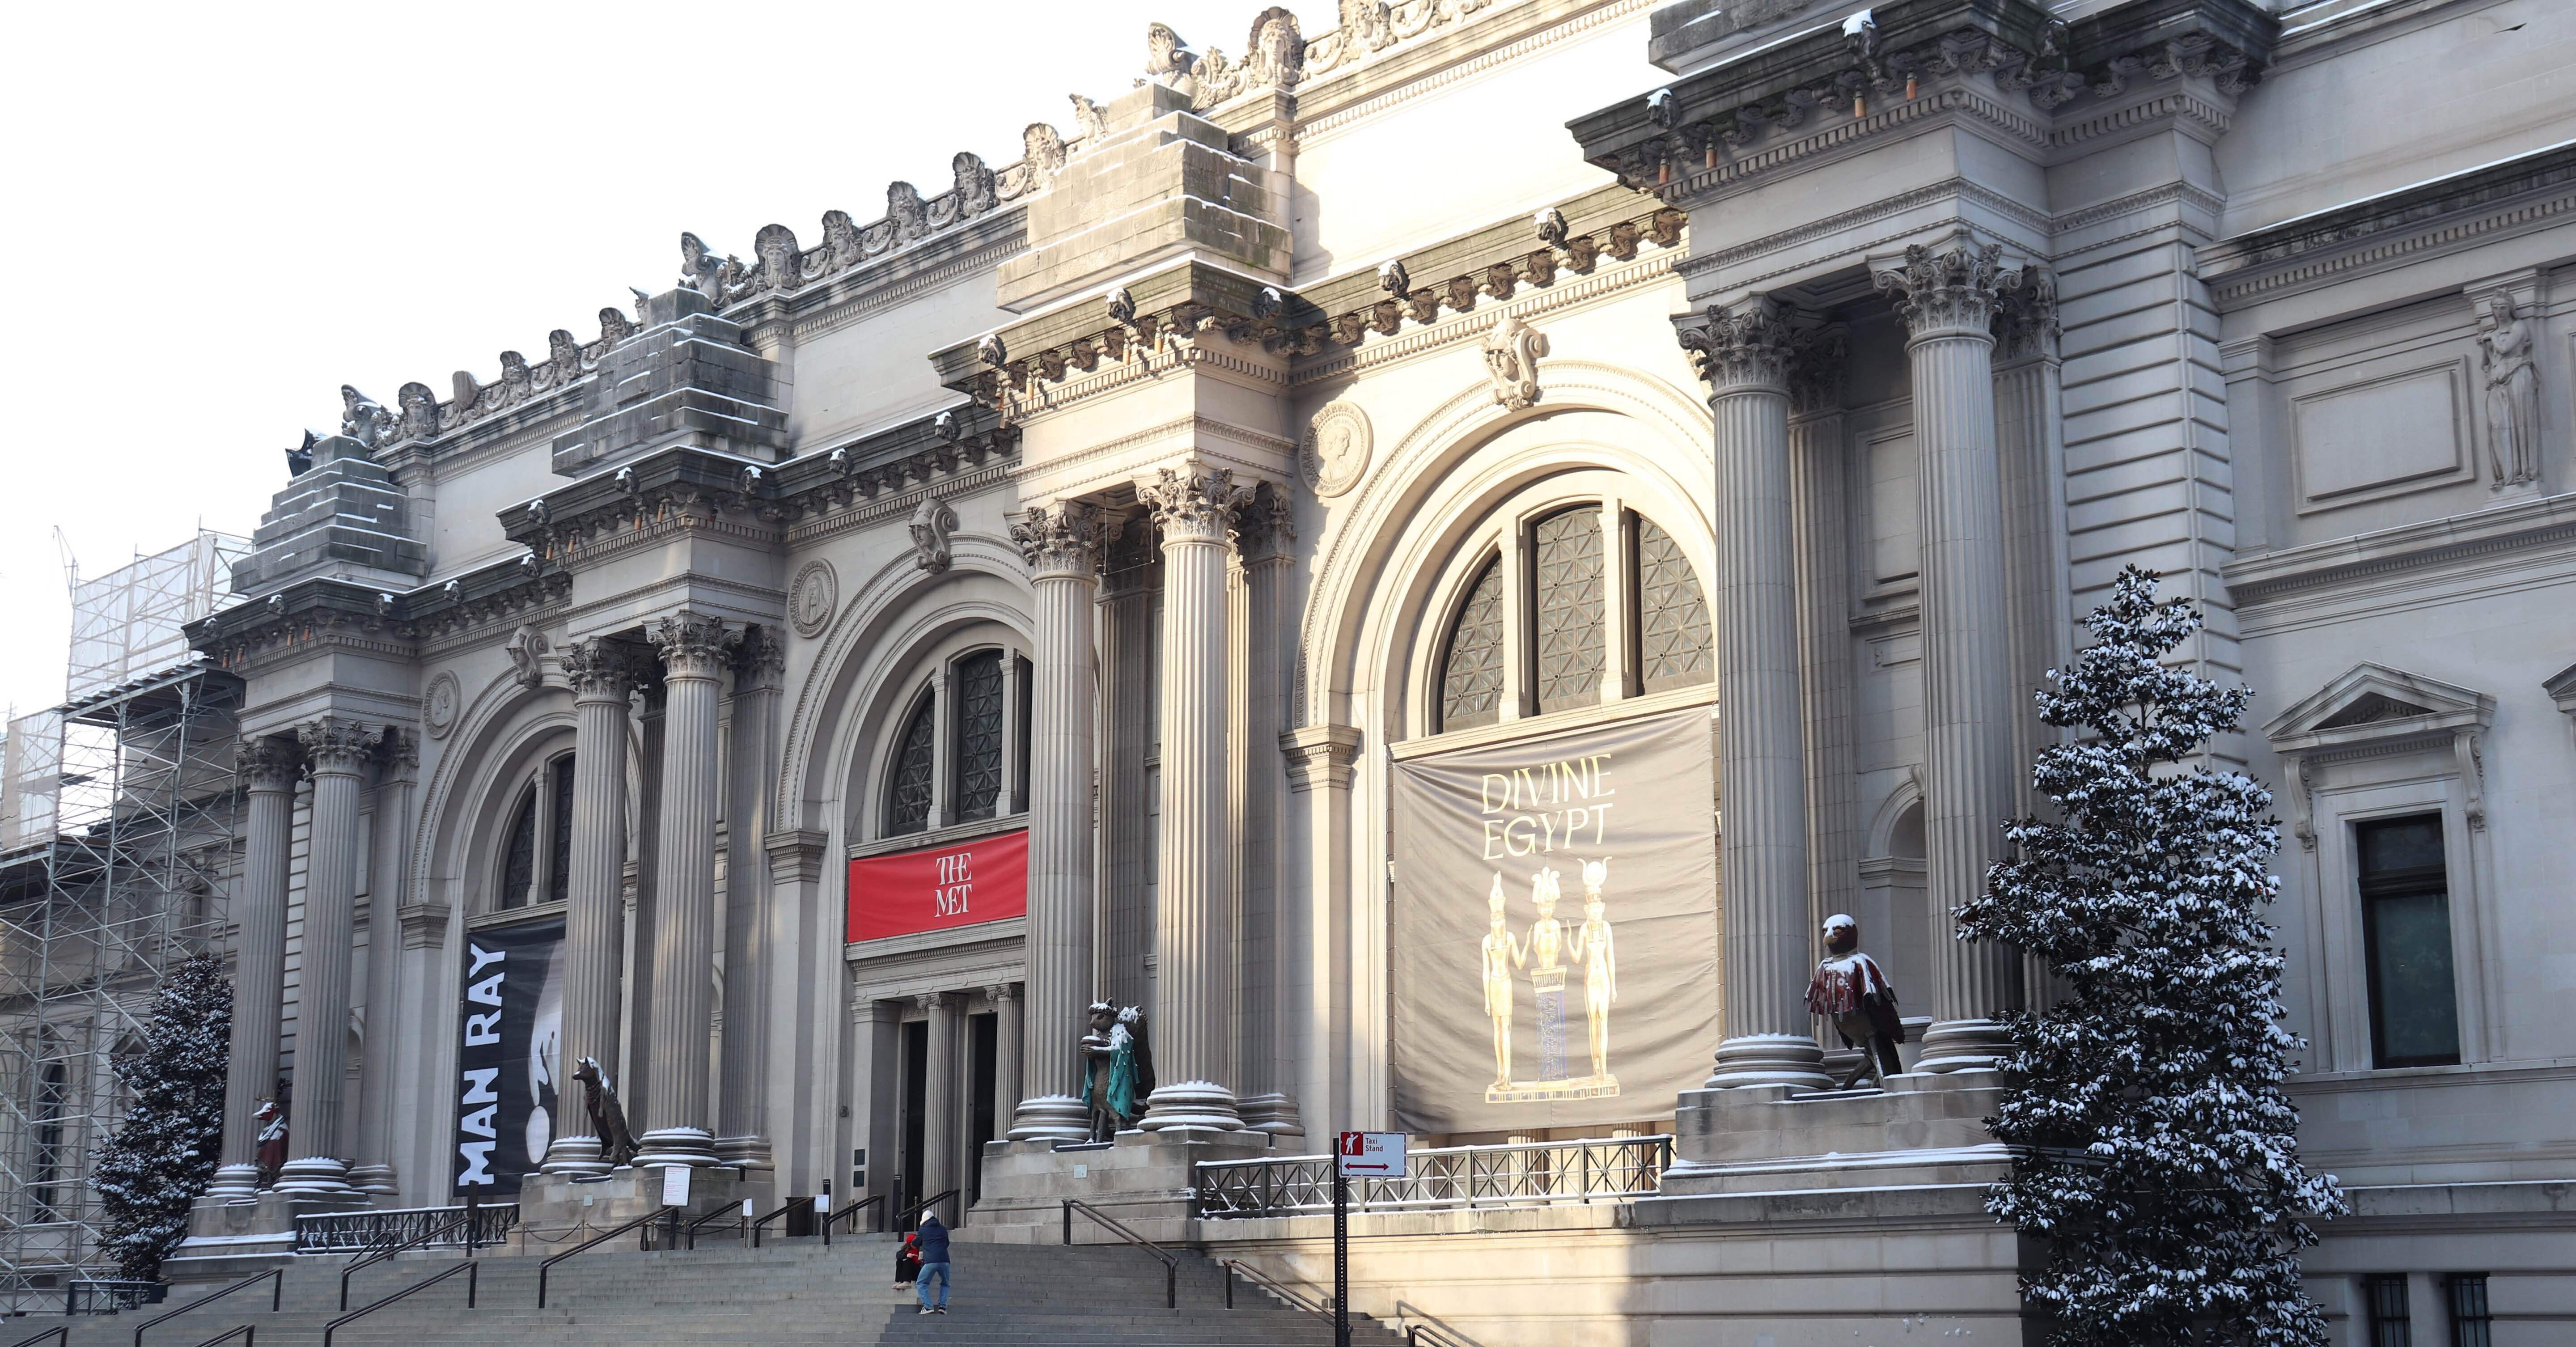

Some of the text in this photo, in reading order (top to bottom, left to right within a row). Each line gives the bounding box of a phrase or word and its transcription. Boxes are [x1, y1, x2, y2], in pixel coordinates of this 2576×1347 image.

[1482, 753, 1615, 814] DIVINE
[1483, 802, 1614, 860] EGYPT
[935, 852, 972, 885] THE
[934, 883, 973, 918] MET
[458, 942, 506, 1186] MAN RAY
